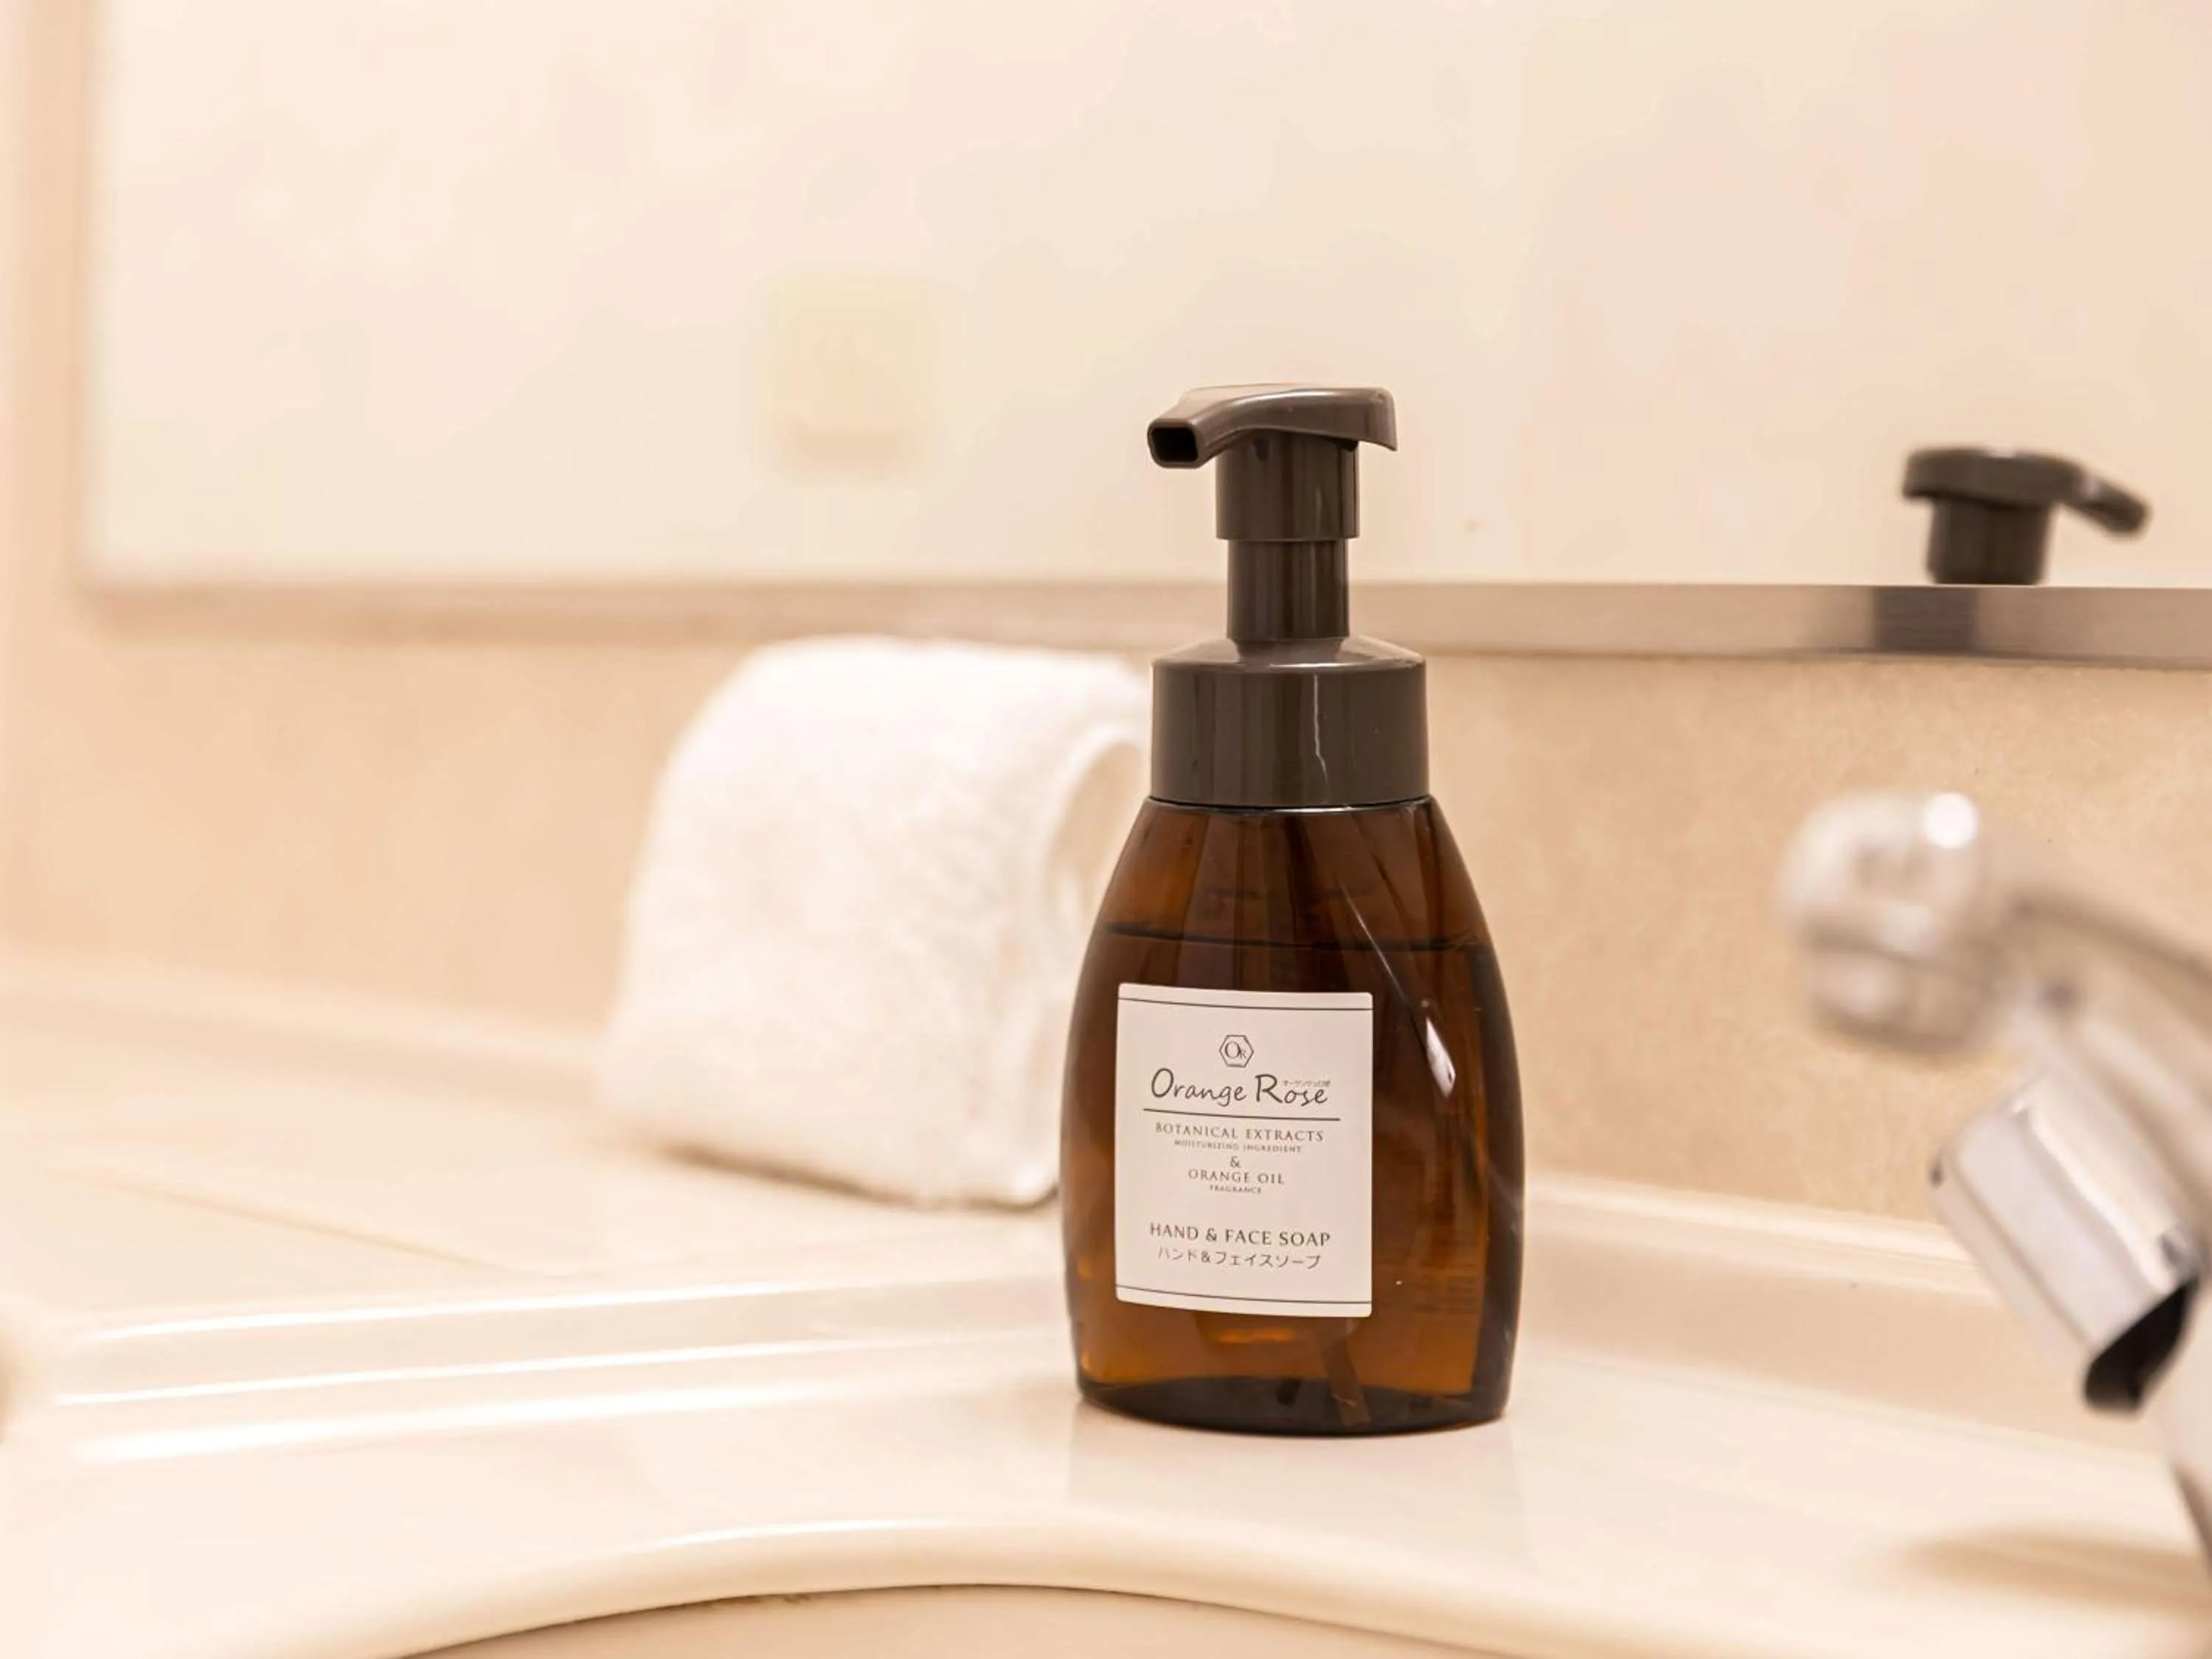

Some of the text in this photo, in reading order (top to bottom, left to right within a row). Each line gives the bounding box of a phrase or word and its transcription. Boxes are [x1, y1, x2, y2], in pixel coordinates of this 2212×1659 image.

[1151, 1068, 1328, 1107] Orange Rose
[1155, 1122, 1324, 1142] BOTANICAL EXTRACTS
[1174, 1139, 1301, 1153] MOISTURIZING INGREDIENT
[1229, 1155, 1241, 1168] &
[1188, 1169, 1285, 1185] ORANGE OIL
[1209, 1185, 1262, 1194] FRAGRANCE
[1150, 1222, 1331, 1247] HAND & FACE SOAP
